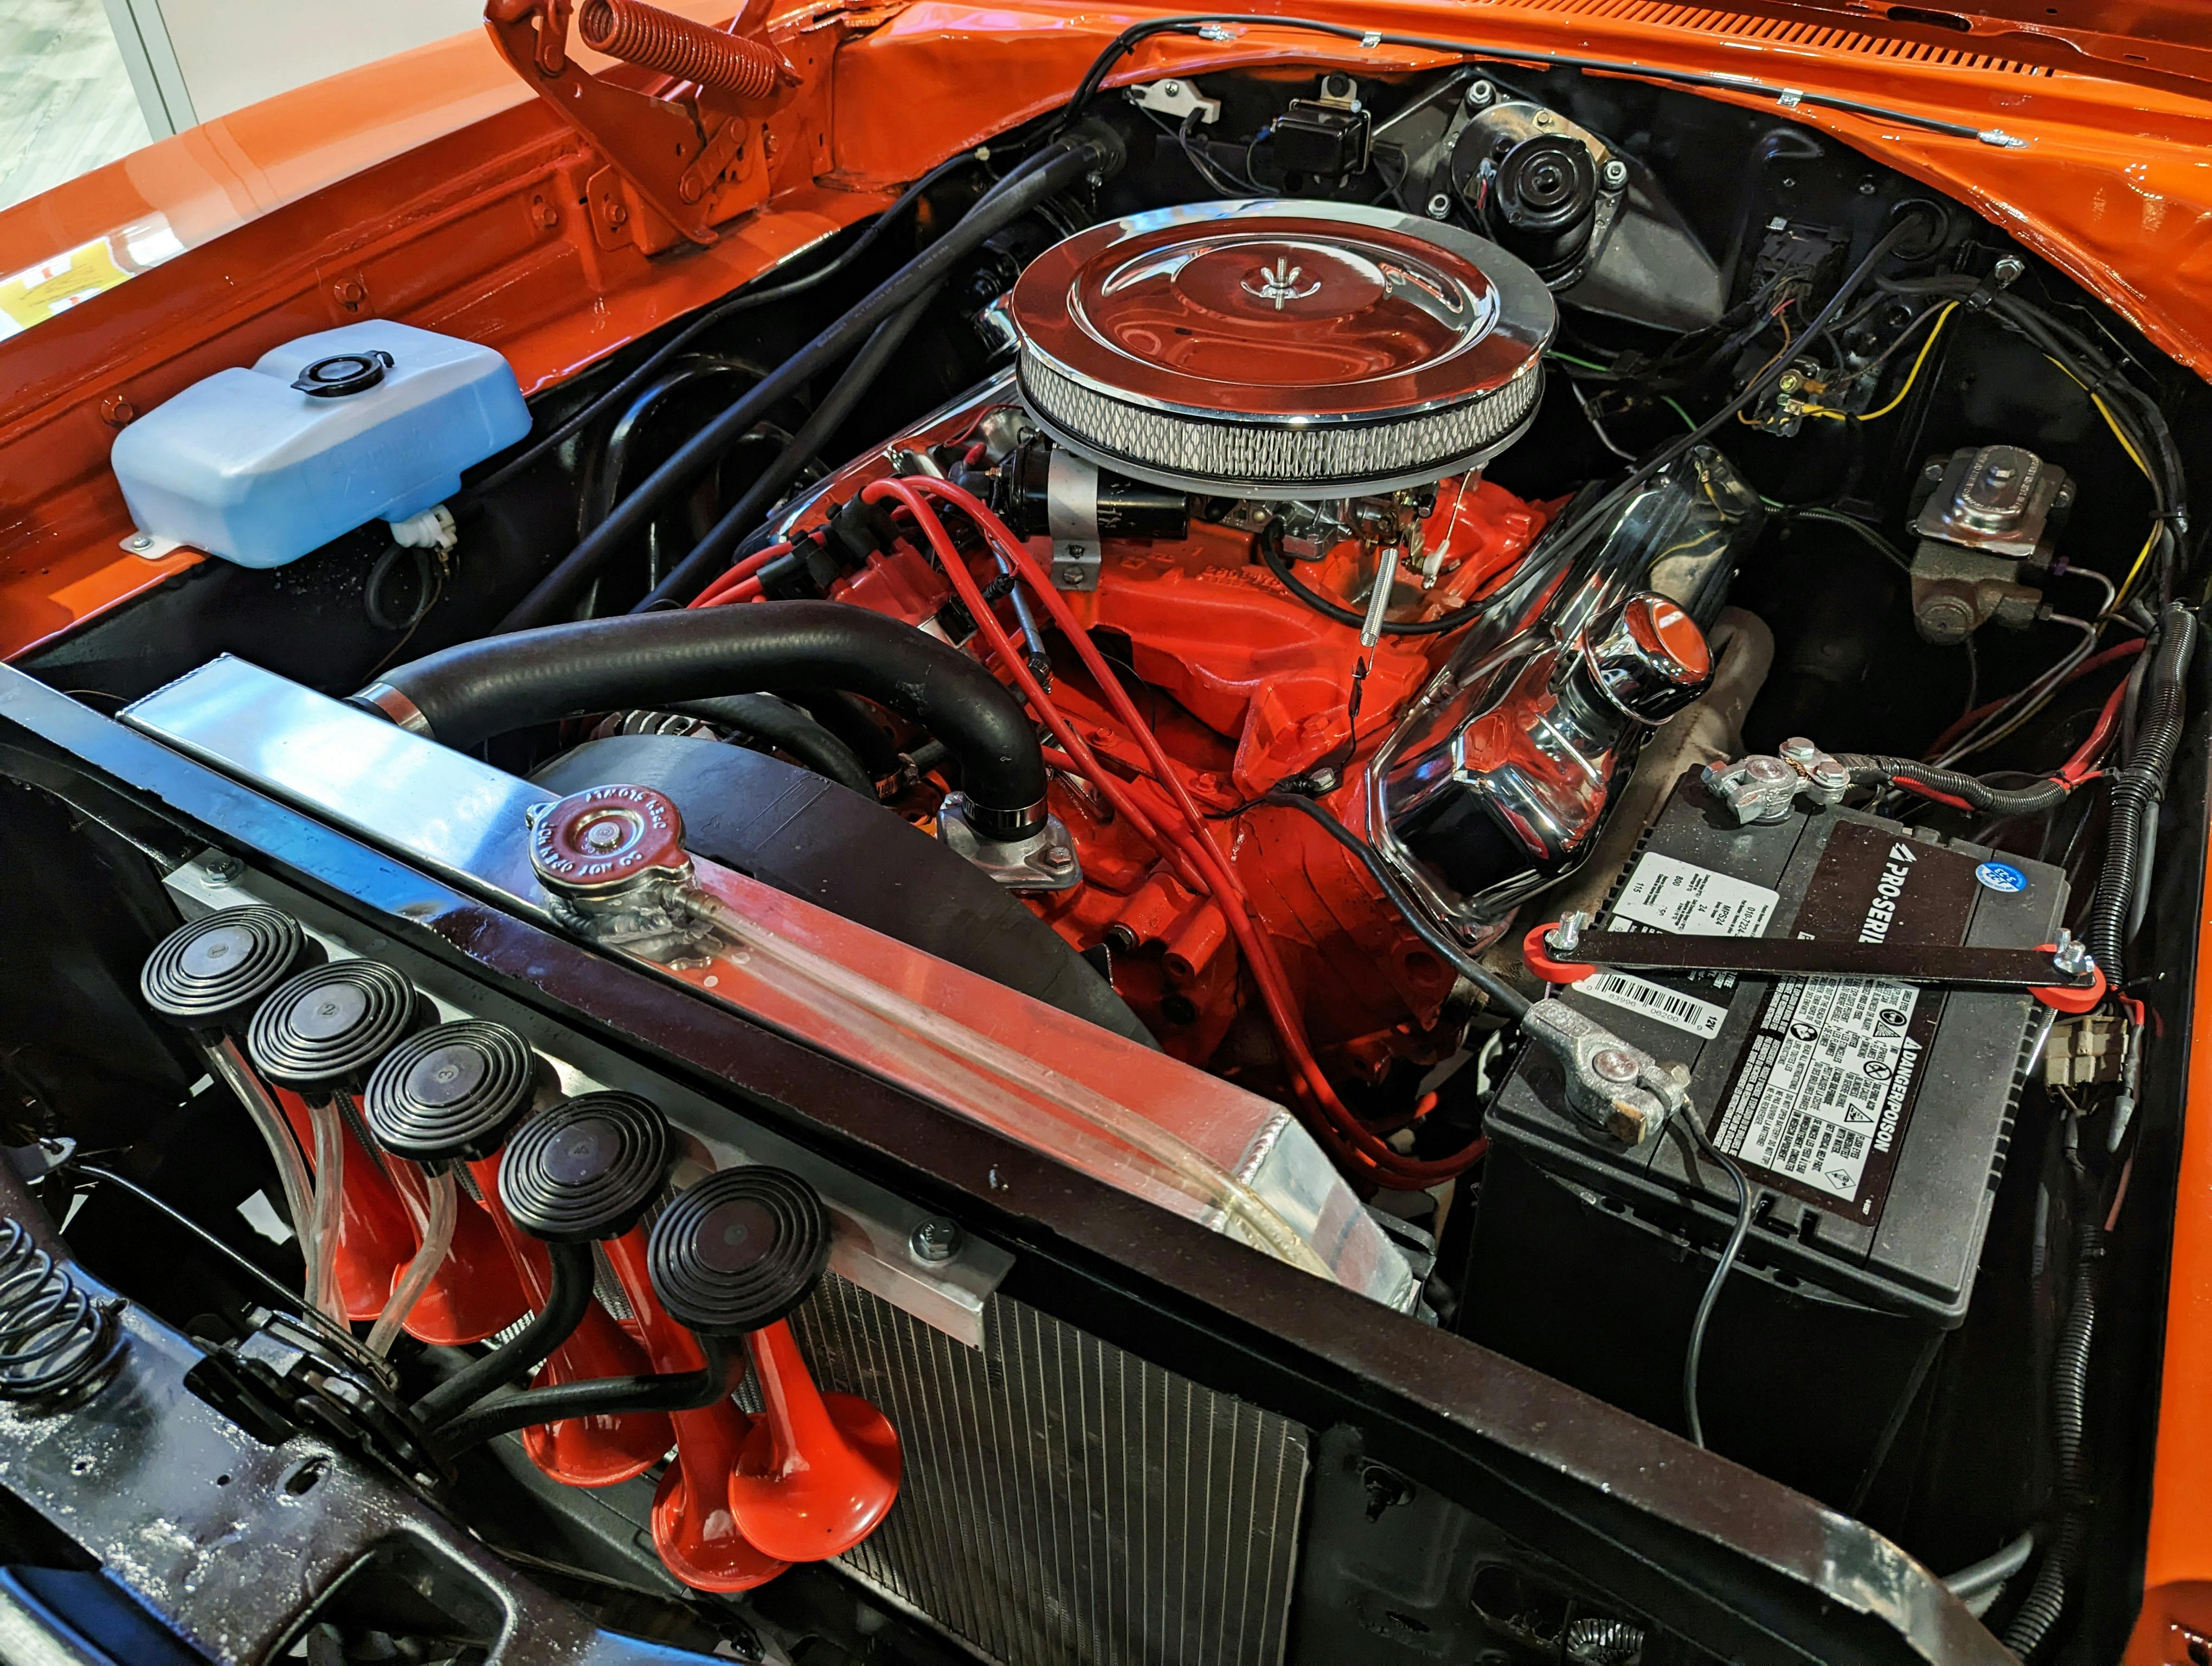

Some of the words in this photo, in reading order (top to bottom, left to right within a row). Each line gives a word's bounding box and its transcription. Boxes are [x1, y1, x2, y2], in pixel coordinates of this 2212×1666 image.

[540, 846, 574, 873] OPEN
[620, 850, 642, 866] DO
[578, 862, 613, 876] NOT
[1632, 881, 1645, 893] 115
[1671, 875, 1684, 887] 800
[1696, 904, 1708, 913] 24
[1709, 909, 1718, 918] Groupe
[1714, 904, 1732, 926] MPS24
[1824, 987, 1833, 996] OUT
[321, 1003, 336, 1016] 2
[1607, 993, 1637, 1007] 83996
[1649, 1008, 1679, 1023] 06200
[1819, 999, 1829, 1008] THE
[1807, 1004, 1818, 1016] HORS
[1815, 1007, 1826, 1020] REACH
[1704, 1015, 1718, 1030] 12V
[1818, 1033, 1830, 1047] FUMER
[1831, 1030, 1841, 1039] LES
[1840, 1033, 1850, 1042] LES
[1792, 1040, 1803, 1050] LIRE
[1802, 1043, 1812, 1055] READ
[1856, 1040, 1870, 1059] SMOKING
[1866, 1042, 1879, 1060] FLAMES
[1786, 1049, 1799, 1065] TOUTES
[1798, 1053, 1808, 1062] ALL
[1875, 1046, 1888, 1062] SPARKS
[1784, 1063, 1793, 1072] LES
[438, 1071, 455, 1080] 3
[1840, 1078, 1852, 1094] SEVERE
[1861, 1078, 1872, 1090] CAN
[1763, 1092, 1772, 1101] PAS
[1774, 1089, 1784, 1097] NE
[1784, 1092, 1793, 1101] DO
[1857, 1087, 1869, 1101] CAUSE
[1771, 1095, 1781, 1105] PAS
[1781, 1099, 1791, 1108] NOT
[1872, 1048, 1918, 1154] DANGER/POISON
[1777, 1107, 1788, 1121] OPEN
[1763, 1119, 1772, 1127] LA
[1824, 1122, 1835, 1133] GET
[1767, 1138, 1777, 1148] DO
[1805, 1138, 1815, 1148] LES
[1764, 1145, 1774, 1156] NOT
[1815, 1149, 1826, 1162] HELP
[1849, 1146, 1861, 1159] EYES
